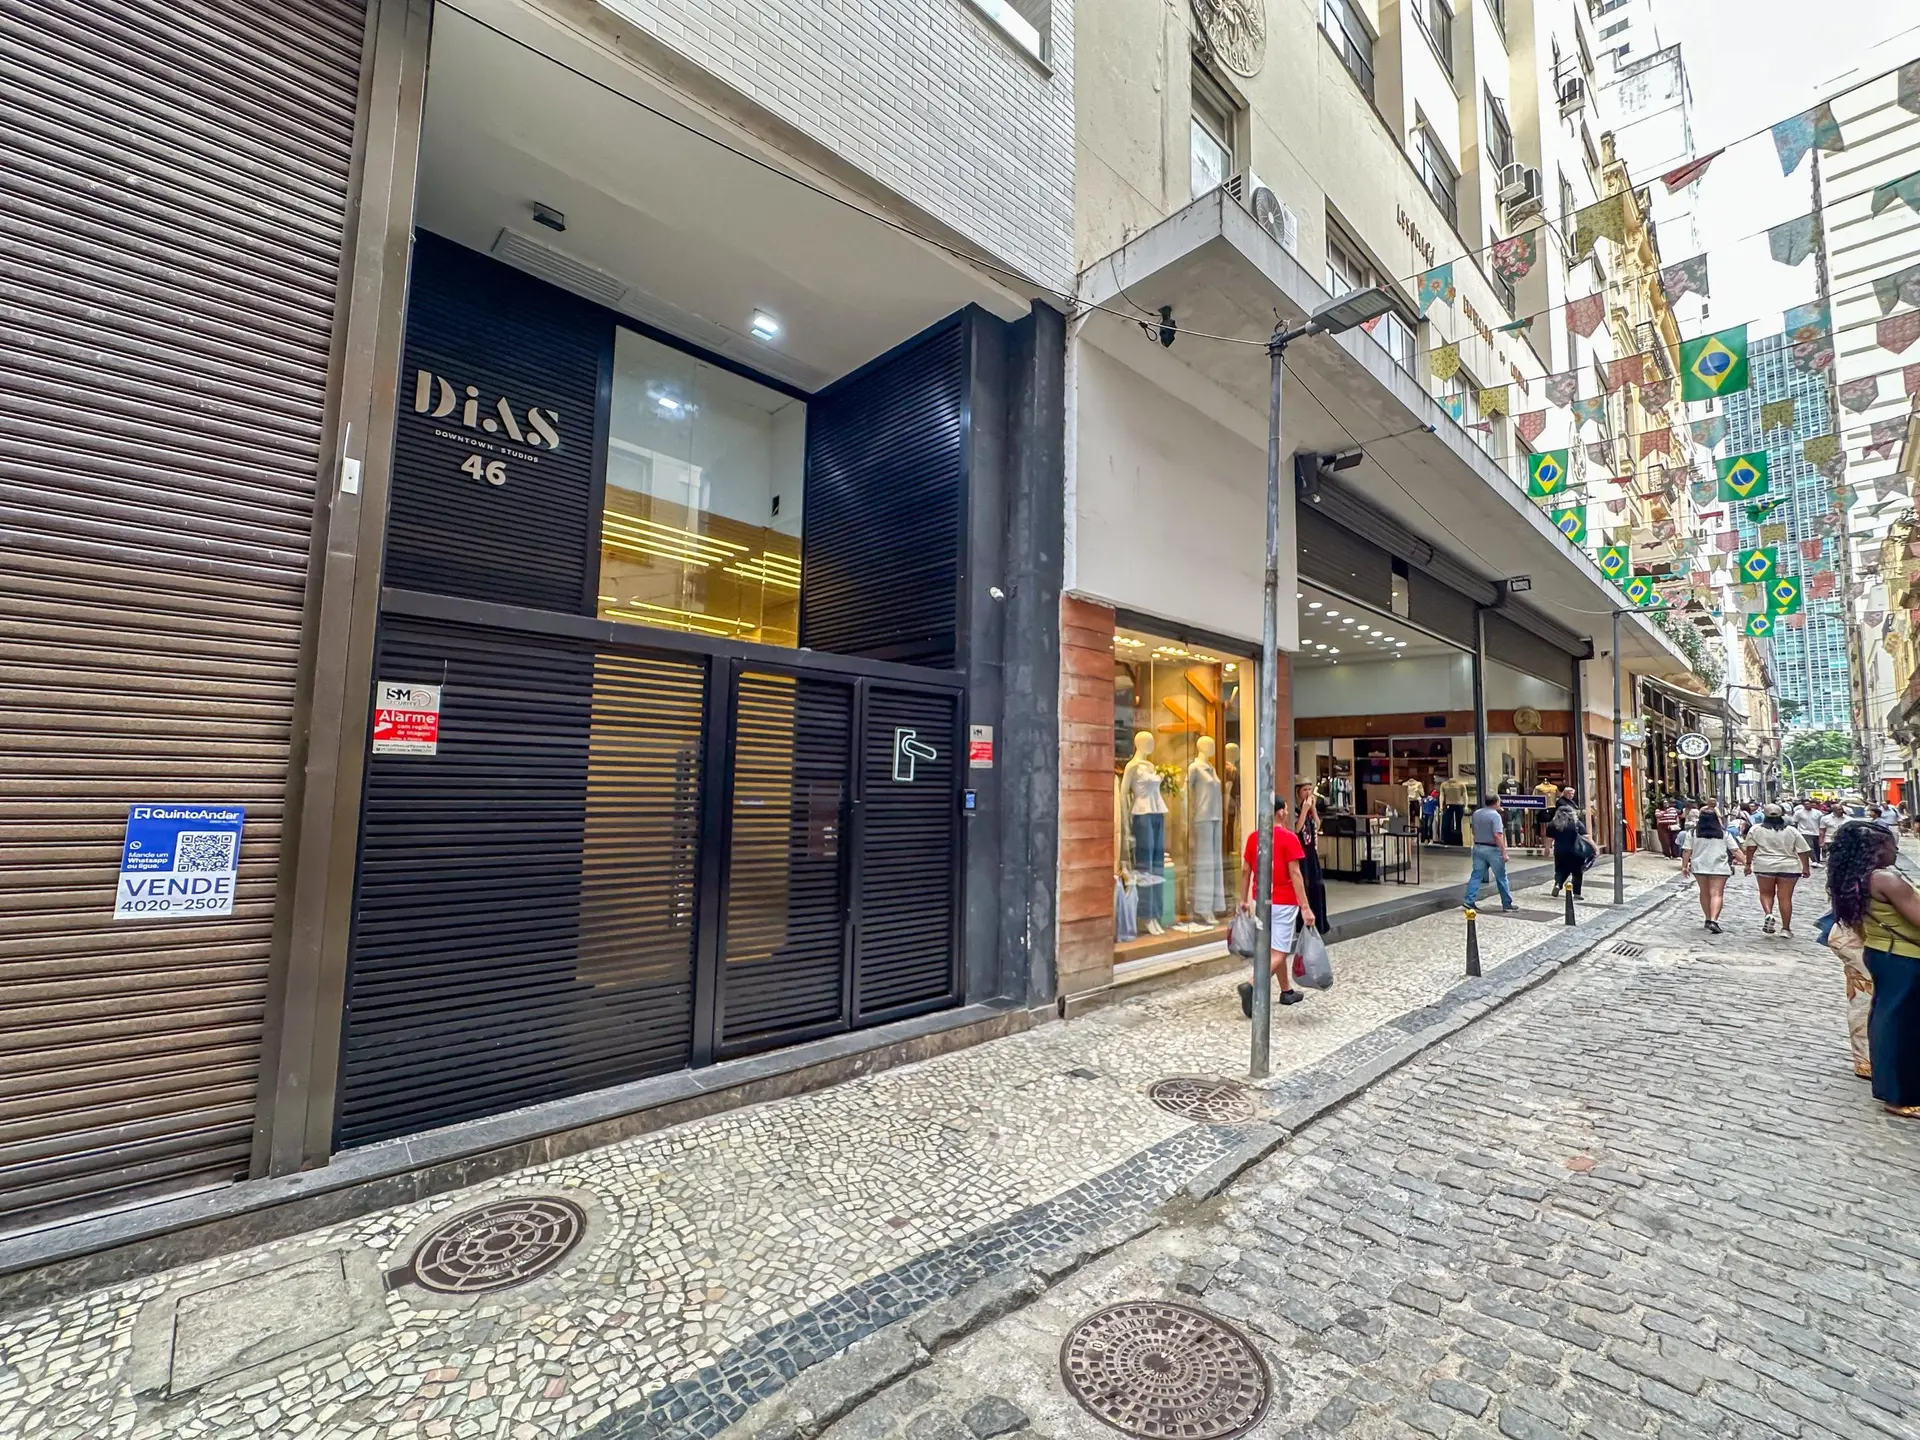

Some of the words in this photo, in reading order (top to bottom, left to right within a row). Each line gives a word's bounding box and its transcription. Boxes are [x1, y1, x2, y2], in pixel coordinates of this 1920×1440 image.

[435, 429, 493, 450] DOWNTOWN
[500, 447, 539, 463] STUDIOS
[460, 453, 507, 486] 46
[379, 710, 436, 724] Alarme
[152, 809, 239, 821] QuintoAndar
[125, 877, 231, 897] VENDE
[120, 898, 228, 912] 4020-2507
[1173, 1385, 1235, 1421] ESGOTO
